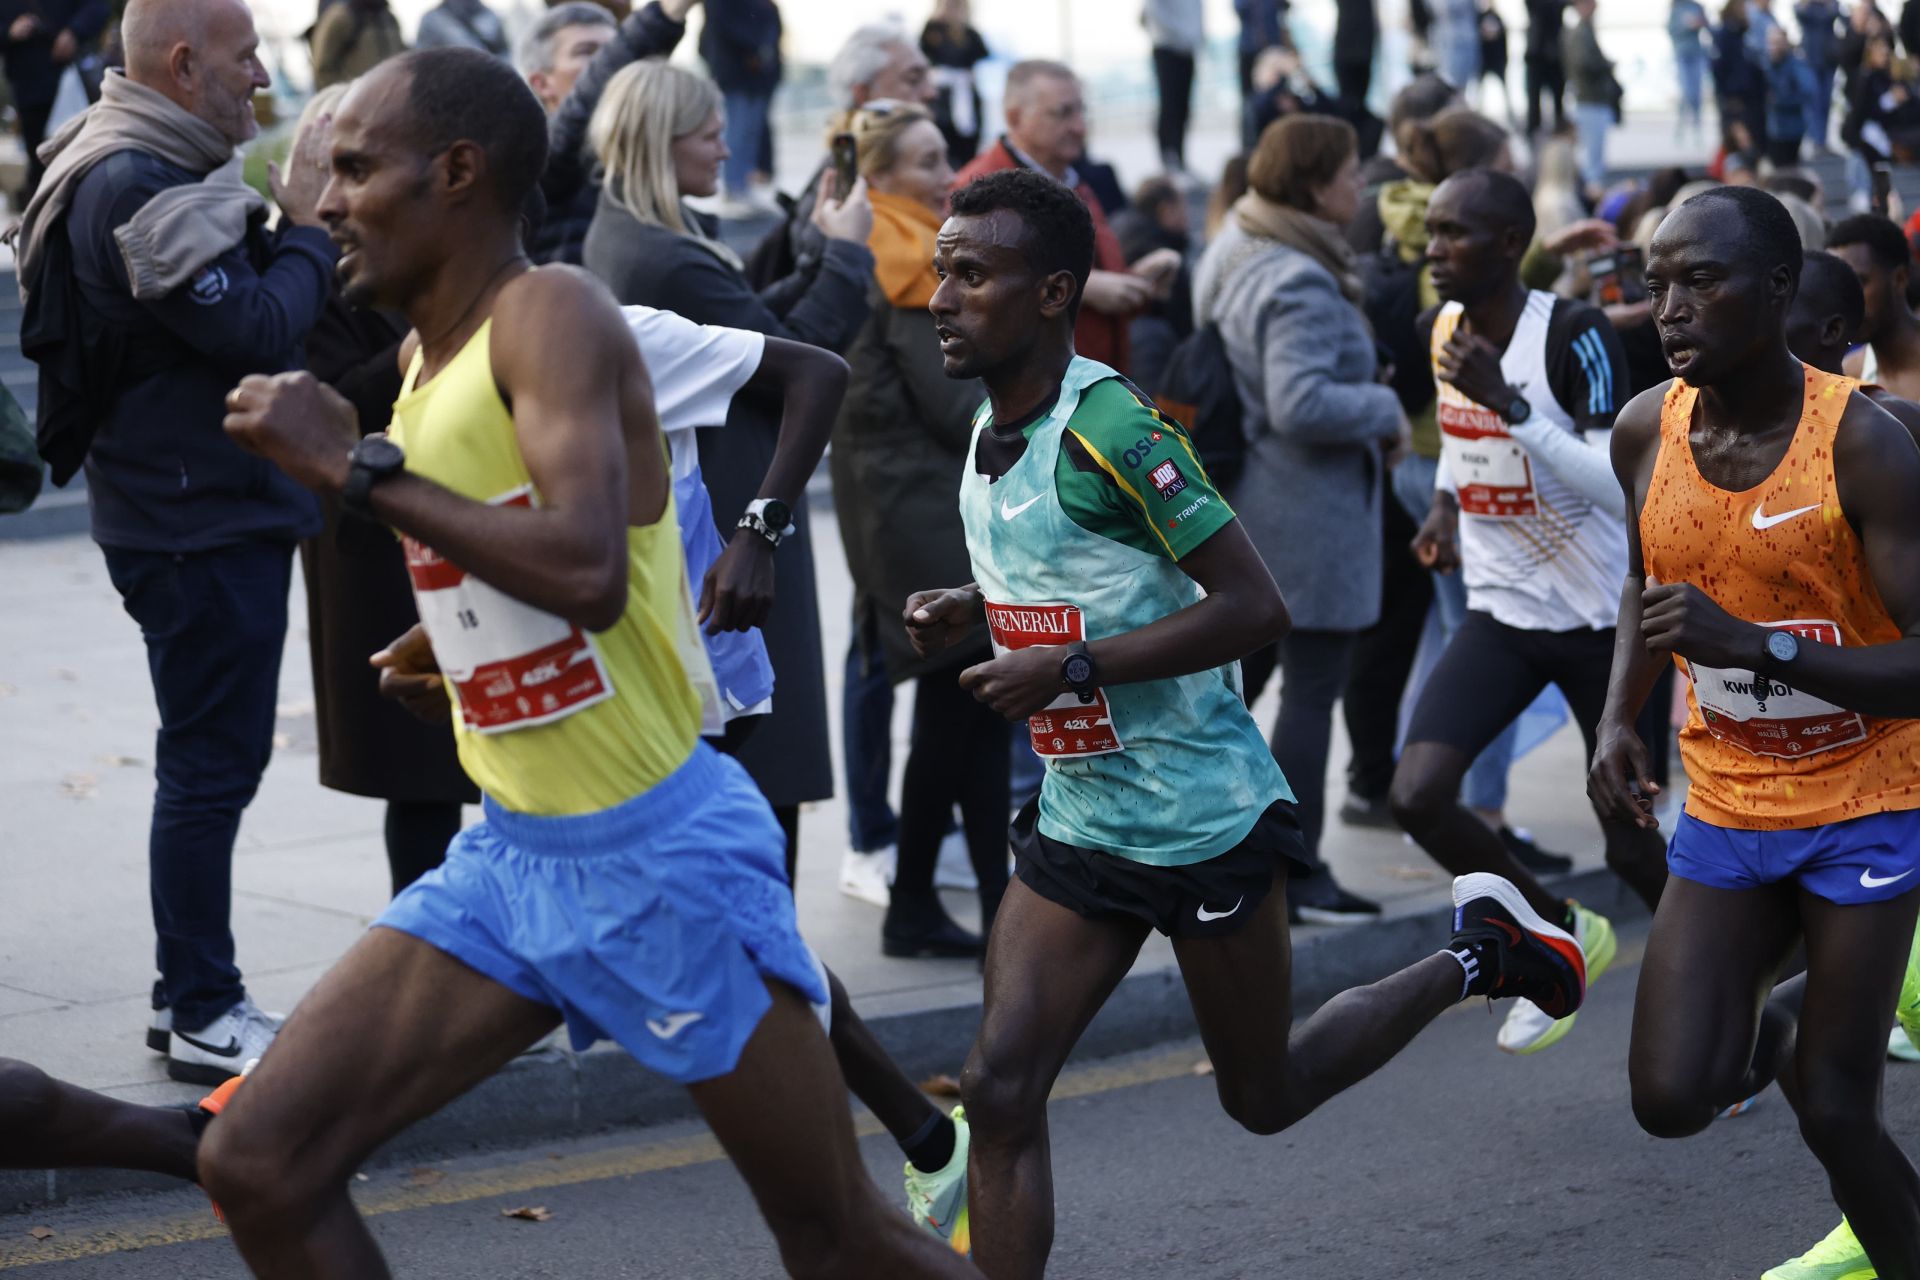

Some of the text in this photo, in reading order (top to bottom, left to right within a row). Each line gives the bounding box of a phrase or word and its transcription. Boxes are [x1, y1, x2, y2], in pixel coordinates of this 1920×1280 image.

[1152, 463, 1178, 489] JOB
[1162, 477, 1187, 501] ZONE
[991, 608, 1071, 634] GENERALI
[1757, 701, 1768, 713] 3
[1064, 719, 1090, 730] 42K
[1801, 724, 1833, 736] 42K
